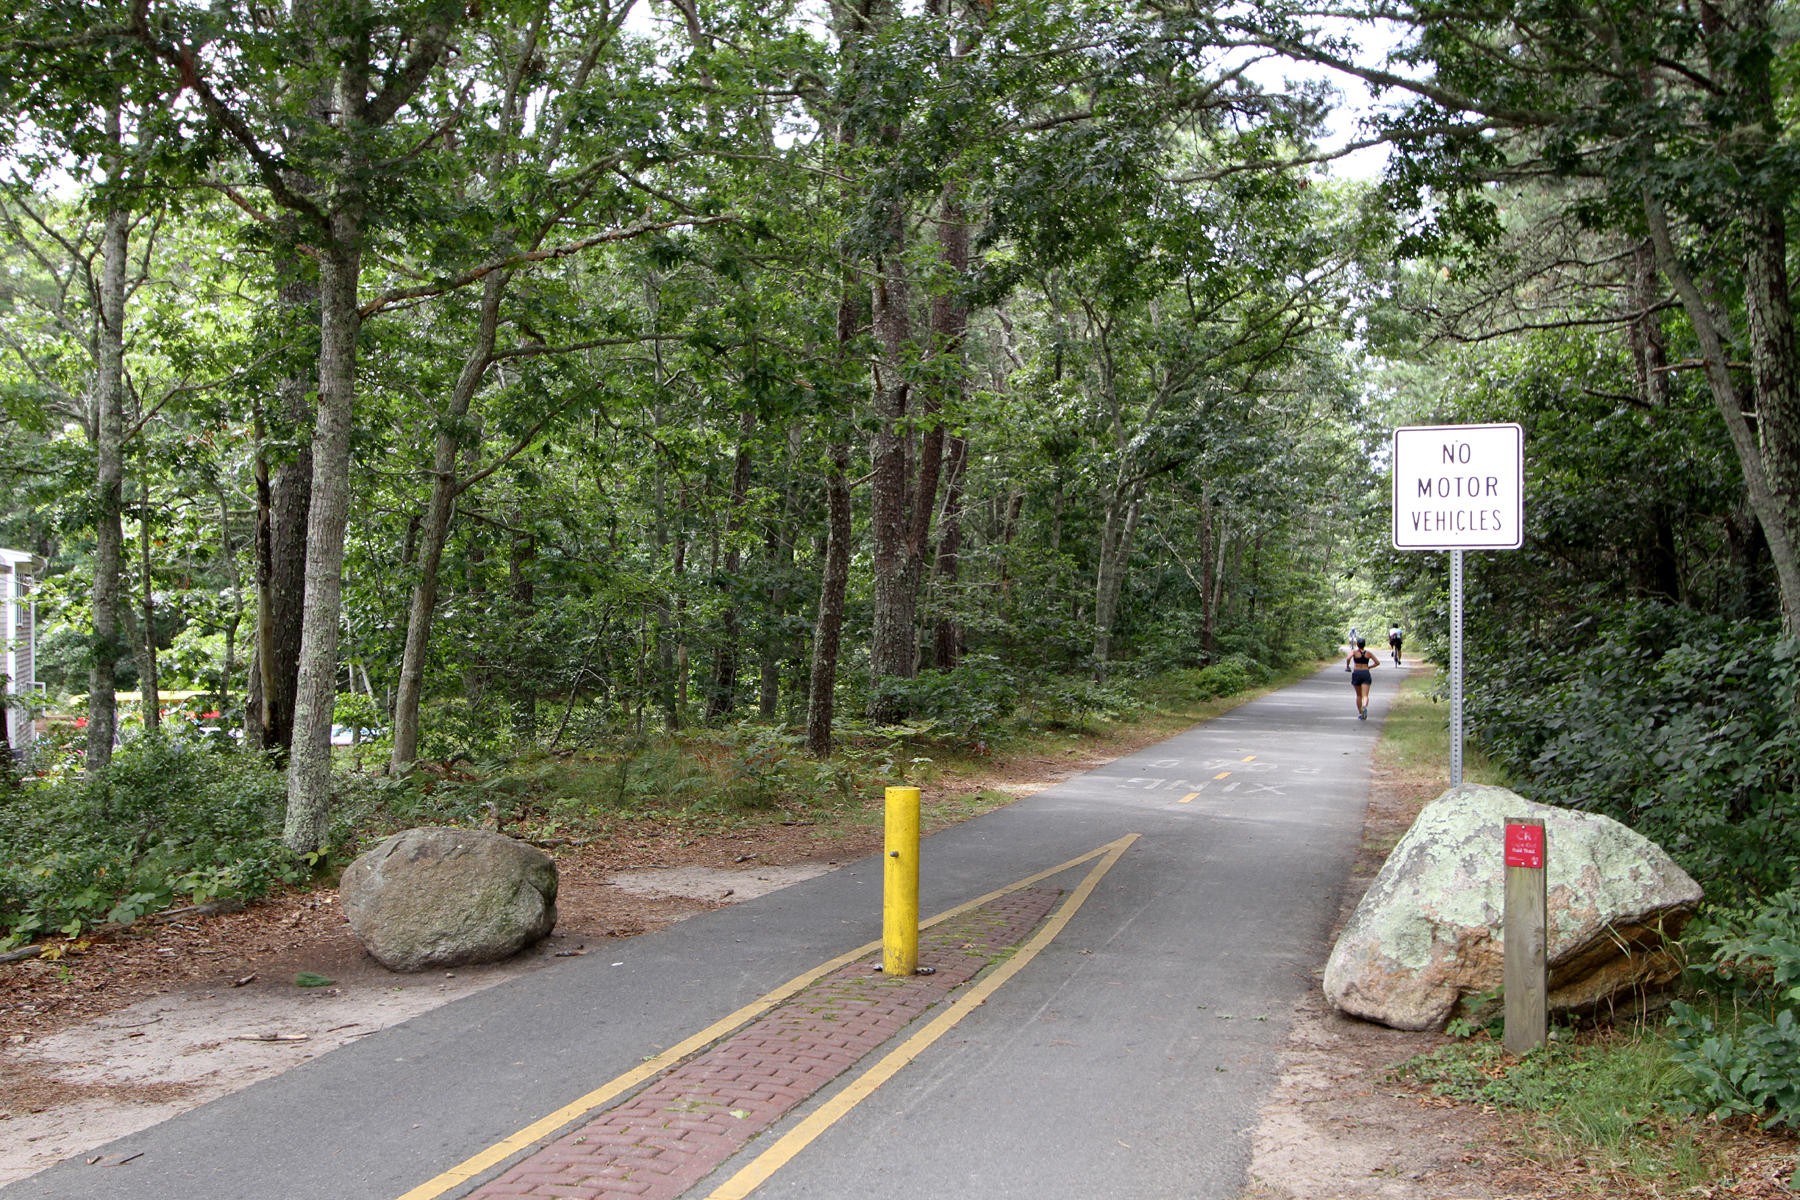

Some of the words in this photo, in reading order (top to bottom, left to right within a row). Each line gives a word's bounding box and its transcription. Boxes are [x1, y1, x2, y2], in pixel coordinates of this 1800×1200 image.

[1442, 443, 1471, 464] NO
[1417, 476, 1498, 498] MOTOR
[1411, 509, 1502, 532] VEHICLES
[1115, 777, 1288, 796] XING
